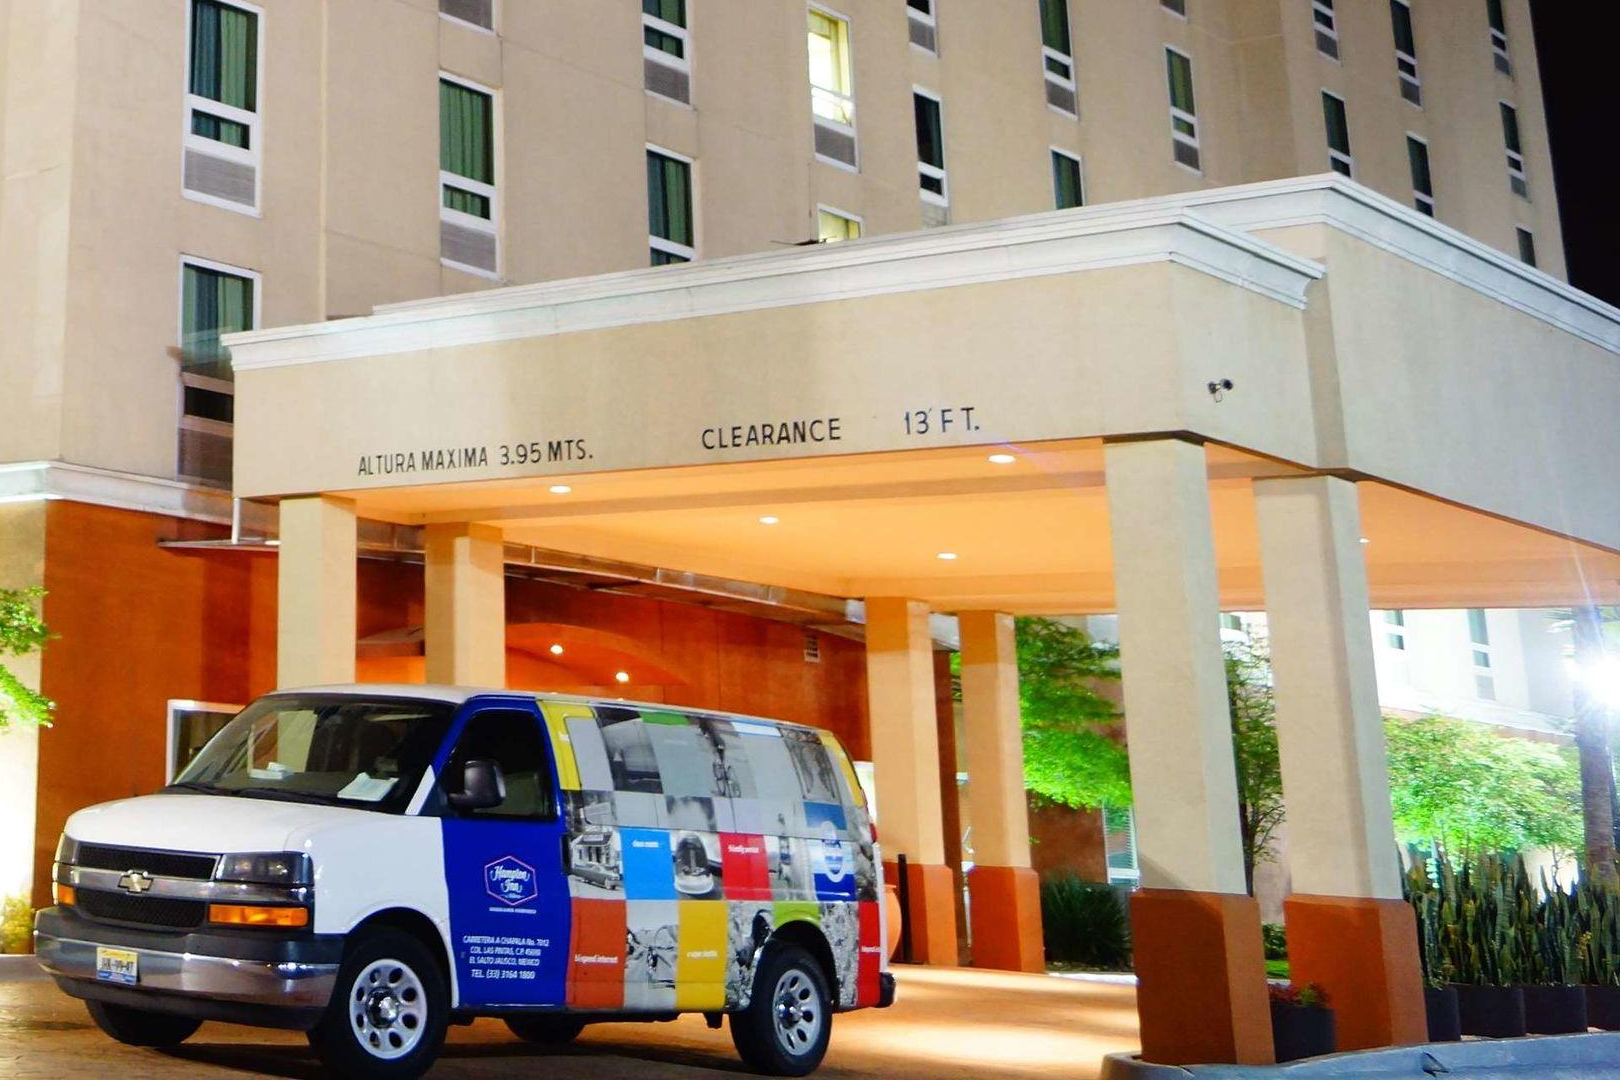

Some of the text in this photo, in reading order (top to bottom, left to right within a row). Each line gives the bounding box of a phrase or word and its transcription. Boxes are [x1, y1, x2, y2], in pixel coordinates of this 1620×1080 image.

[701, 417, 842, 450] CLEARANCE
[357, 438, 594, 476] ALTURA MAXIMA 3.95 MTS.
